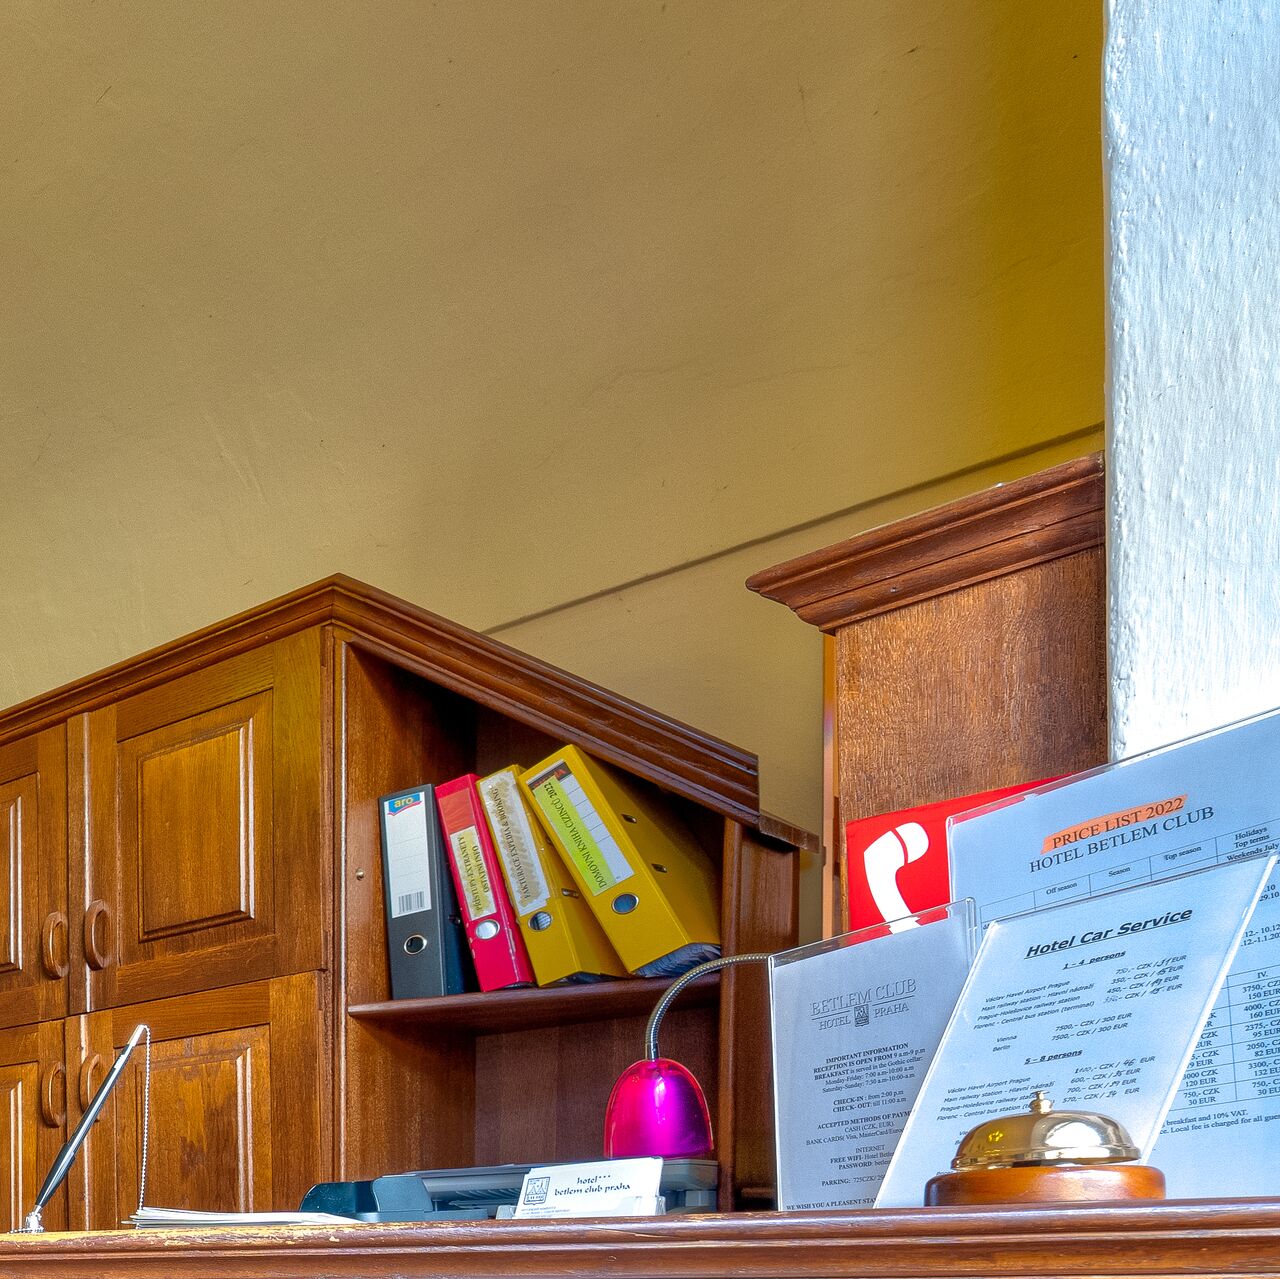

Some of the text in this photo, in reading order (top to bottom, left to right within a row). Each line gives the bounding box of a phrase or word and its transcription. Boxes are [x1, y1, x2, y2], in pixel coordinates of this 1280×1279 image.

[544, 782, 557, 798] 2022
[394, 796, 414, 808] aro
[493, 789, 506, 820] BOOKING
[1052, 798, 1184, 849] PRICE LIST 2022
[570, 827, 587, 852] KNIHA
[1029, 806, 1214, 873] HOTEL BETLEM CLUB
[1235, 826, 1268, 840] Holidays
[504, 827, 517, 856] EXPEDIA
[1234, 834, 1270, 849] Top terms
[1164, 846, 1201, 861] Top season
[1108, 866, 1130, 877] Season
[1046, 882, 1078, 896] Off season
[1026, 909, 1193, 958] Hotel Car Service
[1090, 951, 1126, 964] persons
[810, 978, 917, 1016] BETLEM CLUB
[819, 1003, 909, 1030] HOTEL PRAHA
[826, 1043, 909, 1063] IMPORTANT INFORMATION
[1048, 1050, 1083, 1061] persons
[814, 1062, 847, 1073] RECEPTION
[874, 1053, 893, 1062] FROM
[1197, 1059, 1214, 1067] EUR
[814, 1069, 849, 1080] BREAKFAST
[1200, 1077, 1217, 1085] EUR
[1167, 1117, 1197, 1126] breakfast
[1171, 1125, 1189, 1133] Local
[1211, 1119, 1239, 1128] charged
[555, 1187, 582, 1195] betlem
[605, 1183, 630, 1193] praha
